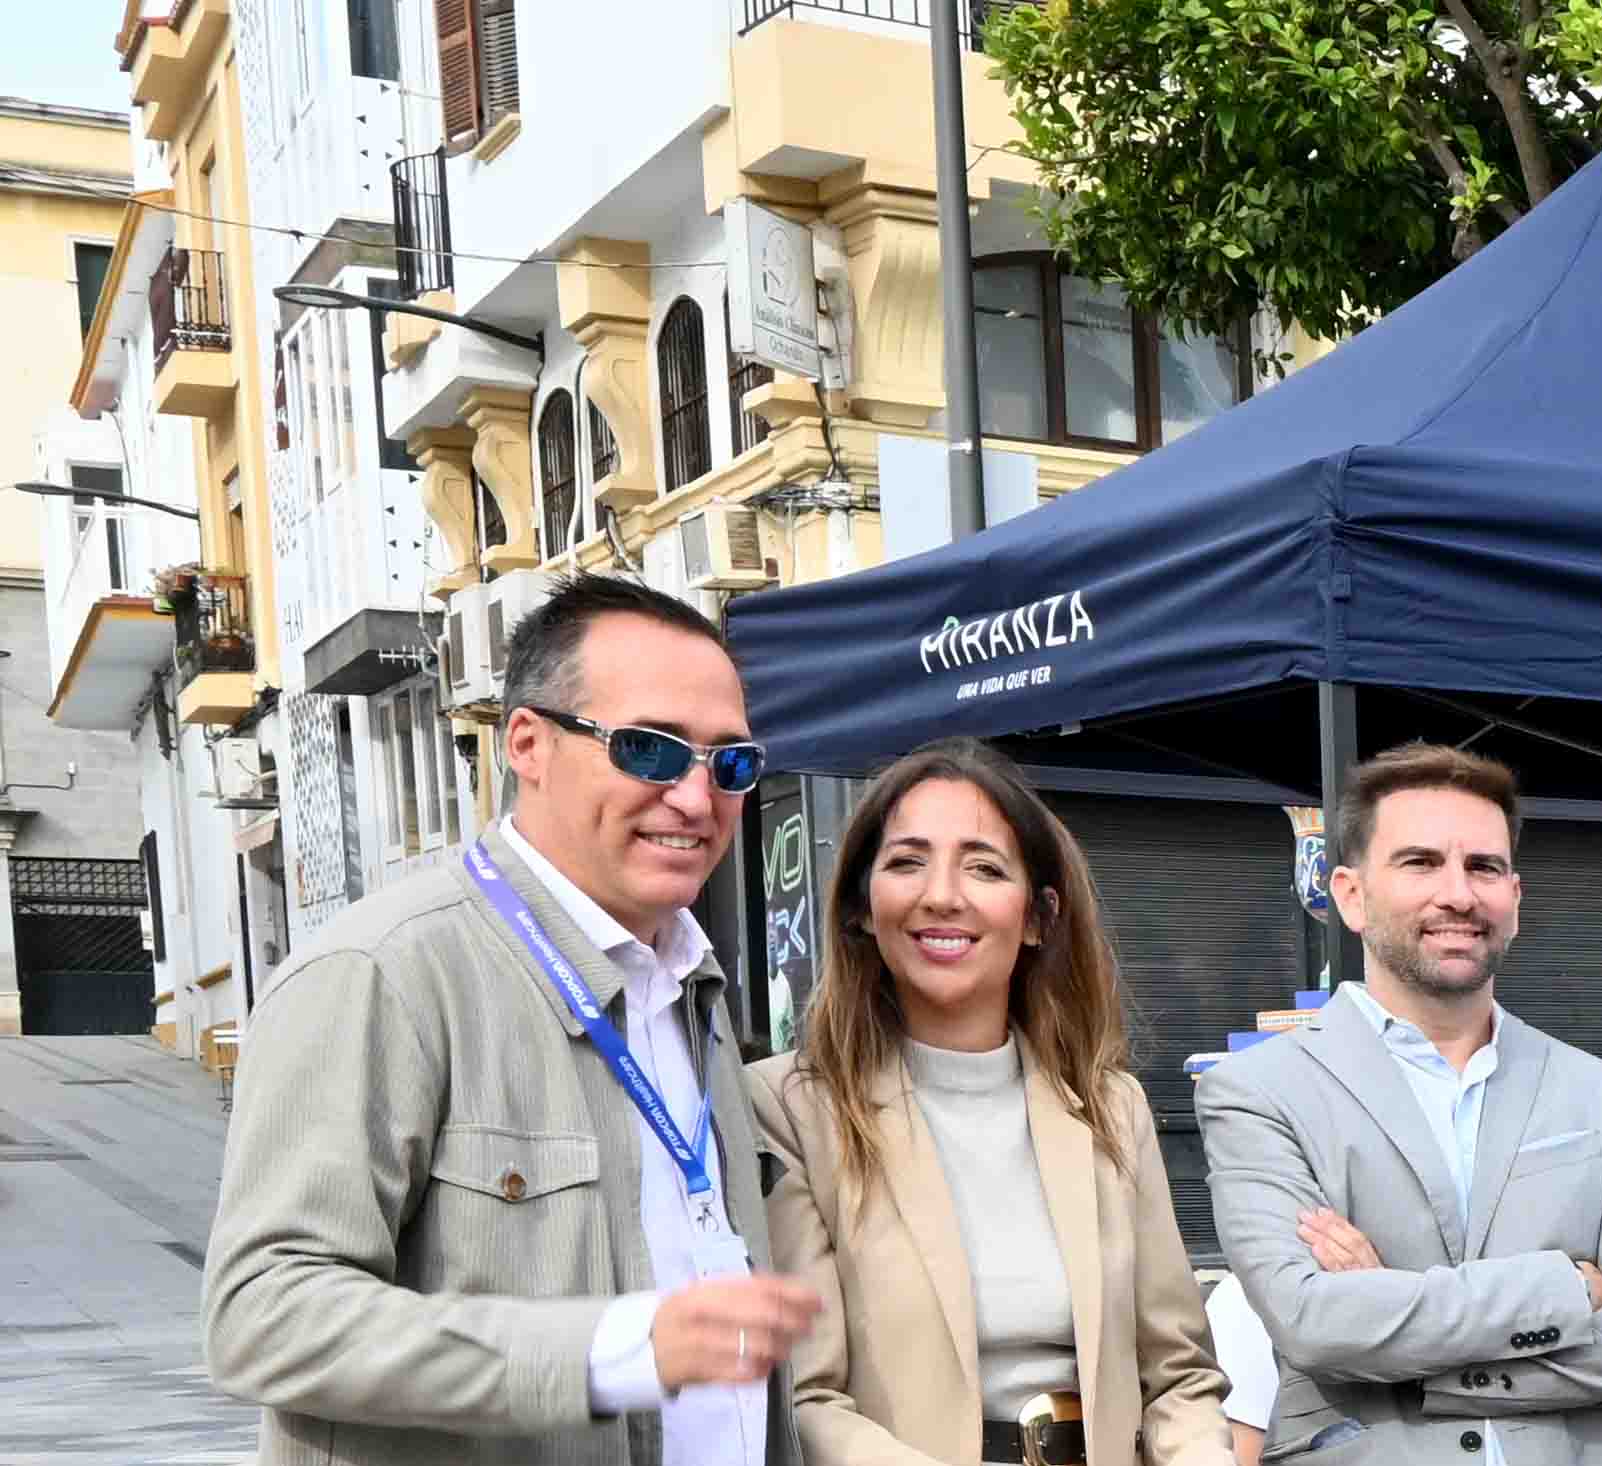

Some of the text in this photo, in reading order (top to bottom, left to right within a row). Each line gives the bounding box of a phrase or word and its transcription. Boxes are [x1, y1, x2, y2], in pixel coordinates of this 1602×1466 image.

[920, 590, 1093, 672] MIRANZA
[957, 666, 1051, 700] UNA VIDA QUE VER
[552, 961, 587, 1010] TOPCON
[652, 1107, 682, 1152] TOPCON
